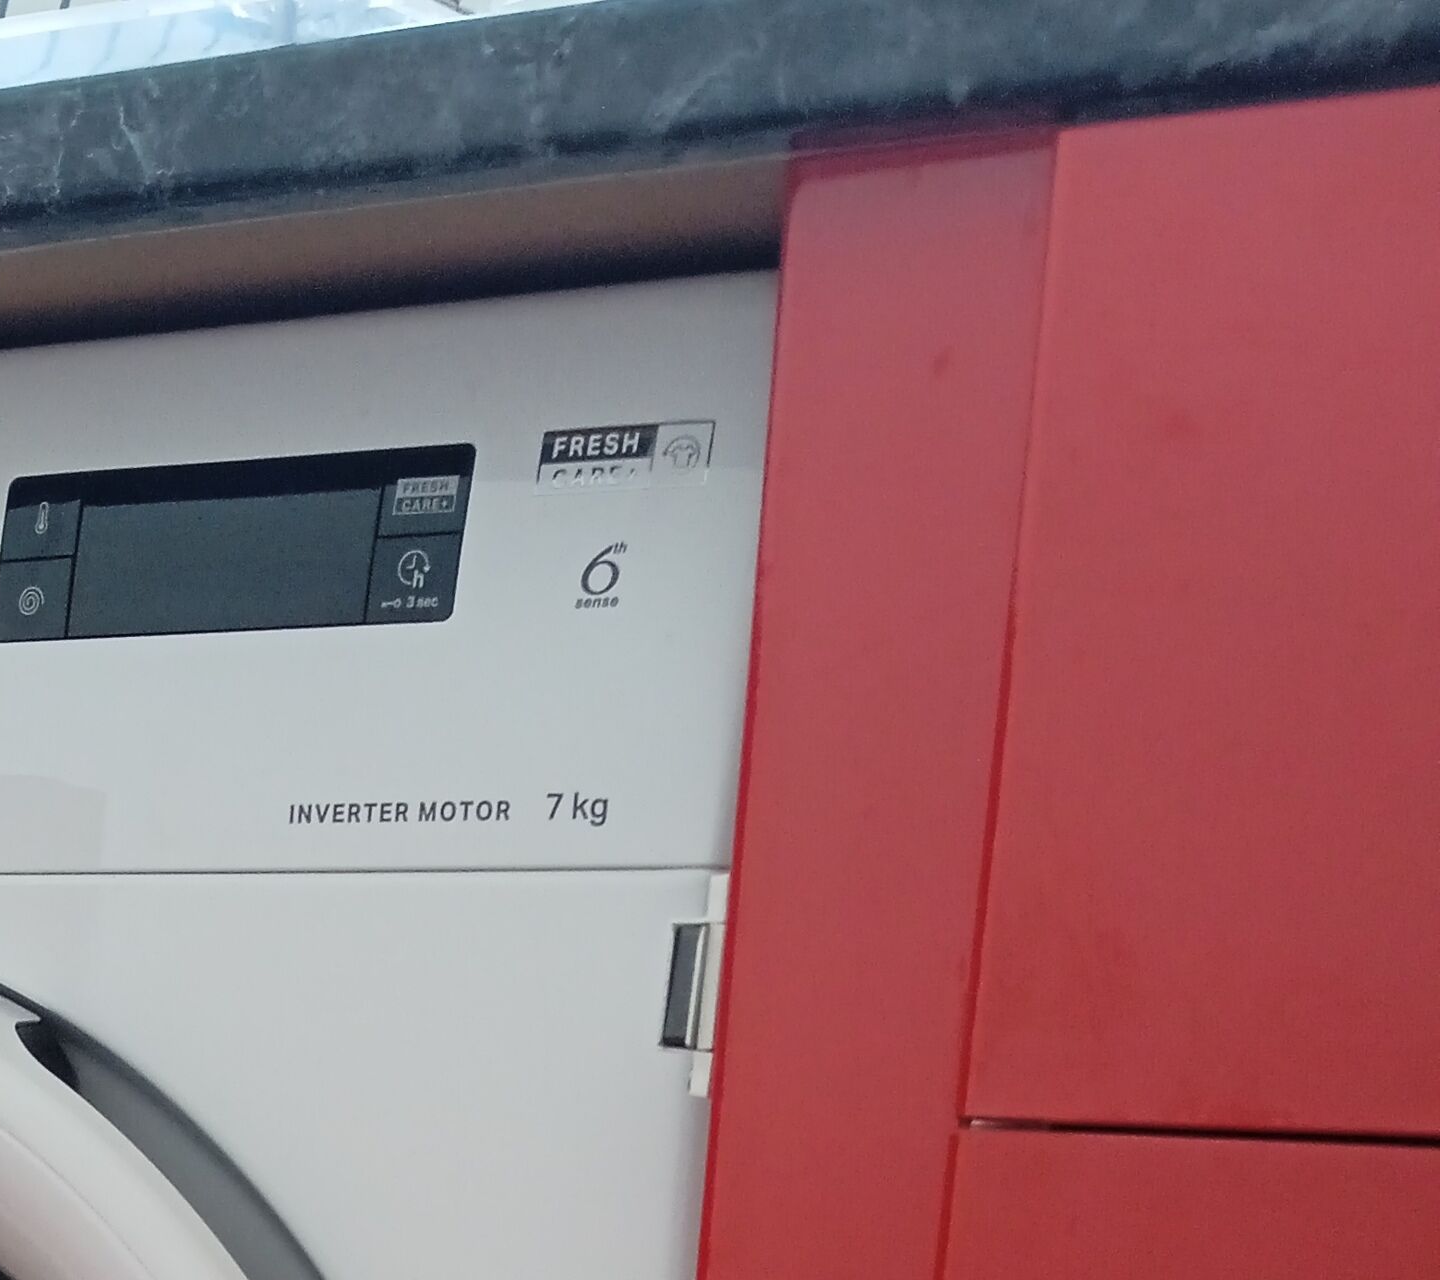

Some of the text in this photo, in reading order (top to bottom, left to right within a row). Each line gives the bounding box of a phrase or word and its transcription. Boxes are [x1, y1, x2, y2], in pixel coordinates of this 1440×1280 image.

[552, 432, 640, 459] FRESH
[402, 480, 449, 494] FRESH
[574, 596, 620, 609] sense
[288, 792, 609, 827] INVERTER MOTOR 7 kg
